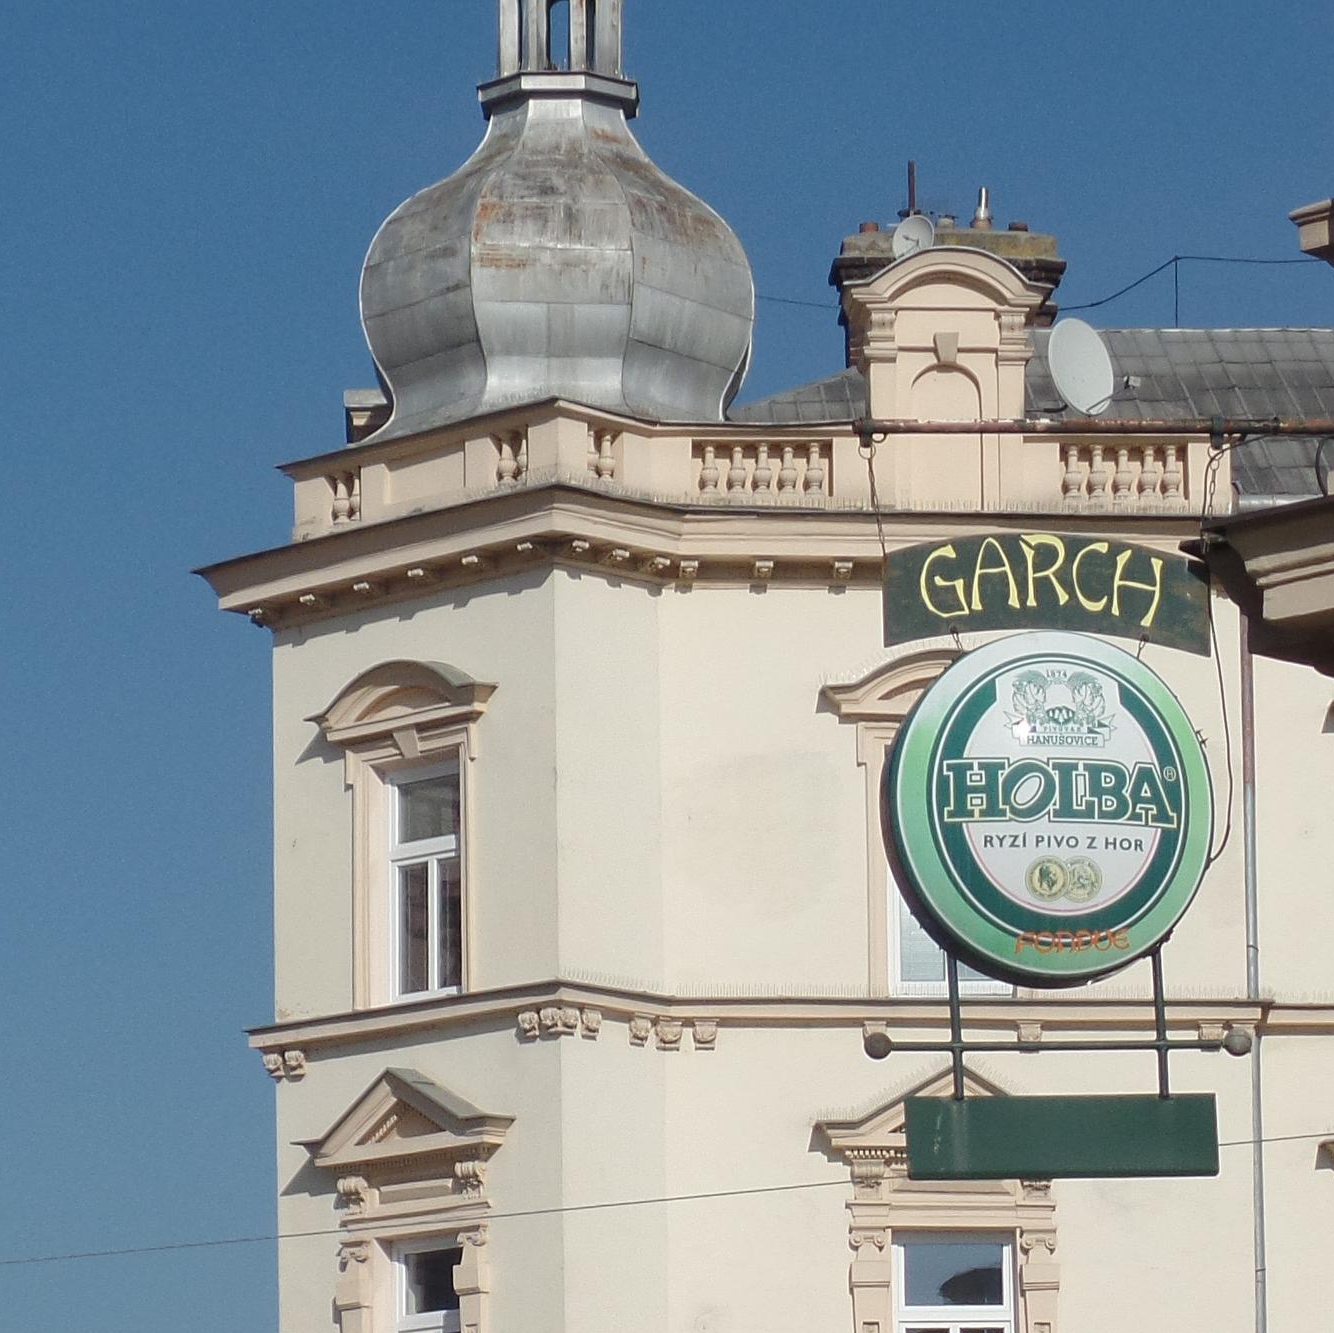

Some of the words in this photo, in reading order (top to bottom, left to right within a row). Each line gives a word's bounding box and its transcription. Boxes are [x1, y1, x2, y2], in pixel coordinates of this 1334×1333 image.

[920, 534, 1163, 627] GARCH
[943, 757, 1179, 829] HOLBA
[983, 832, 1027, 848] RYZÍ
[1035, 835, 1079, 849] PIVO
[1086, 836, 1098, 849] Z
[1104, 837, 1144, 852] HOR
